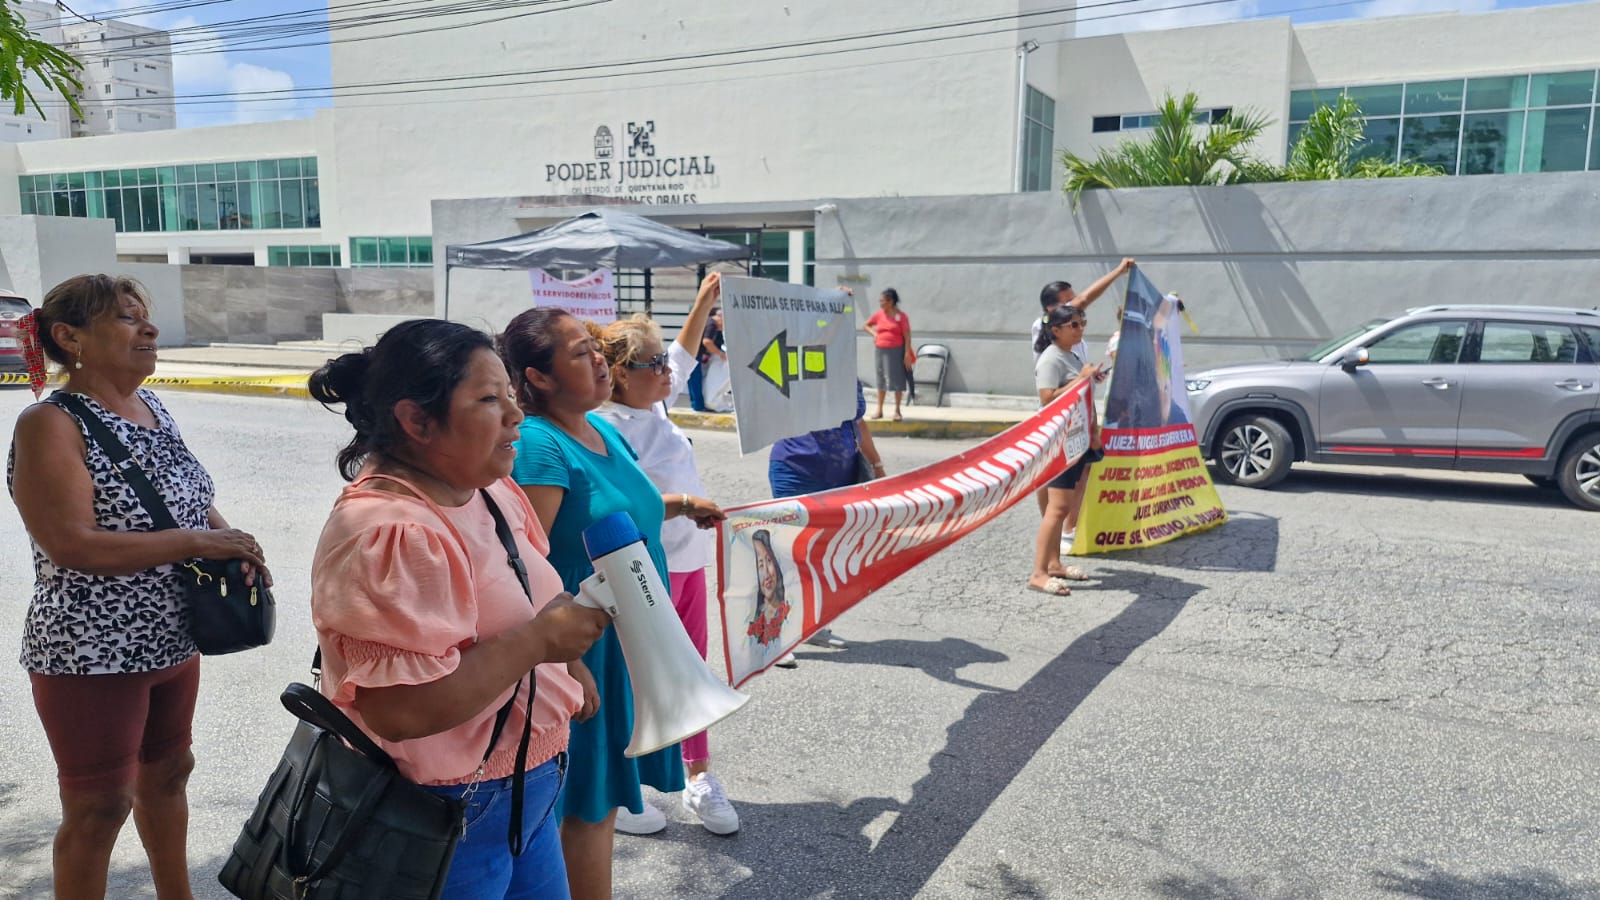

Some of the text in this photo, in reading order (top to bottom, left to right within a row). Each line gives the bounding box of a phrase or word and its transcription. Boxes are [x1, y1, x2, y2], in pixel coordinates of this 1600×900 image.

[545, 155, 715, 184] PODER JUDICIAL
[585, 185, 610, 194] ESTADO
[628, 184, 666, 193] QUINTANA
[668, 183, 685, 191] ROO
[741, 295, 778, 311] JUSTICIA
[779, 297, 790, 312] SE
[790, 298, 806, 313] FUE
[806, 299, 828, 314] PARA
[1104, 435, 1136, 450] JUEZ:
[1099, 467, 1132, 481] JUEZ
[1098, 489, 1126, 504] POR
[1133, 504, 1151, 521] JUEZ
[1095, 532, 1126, 546] QUE
[1129, 529, 1143, 544] SE
[637, 573, 656, 607] Steren
